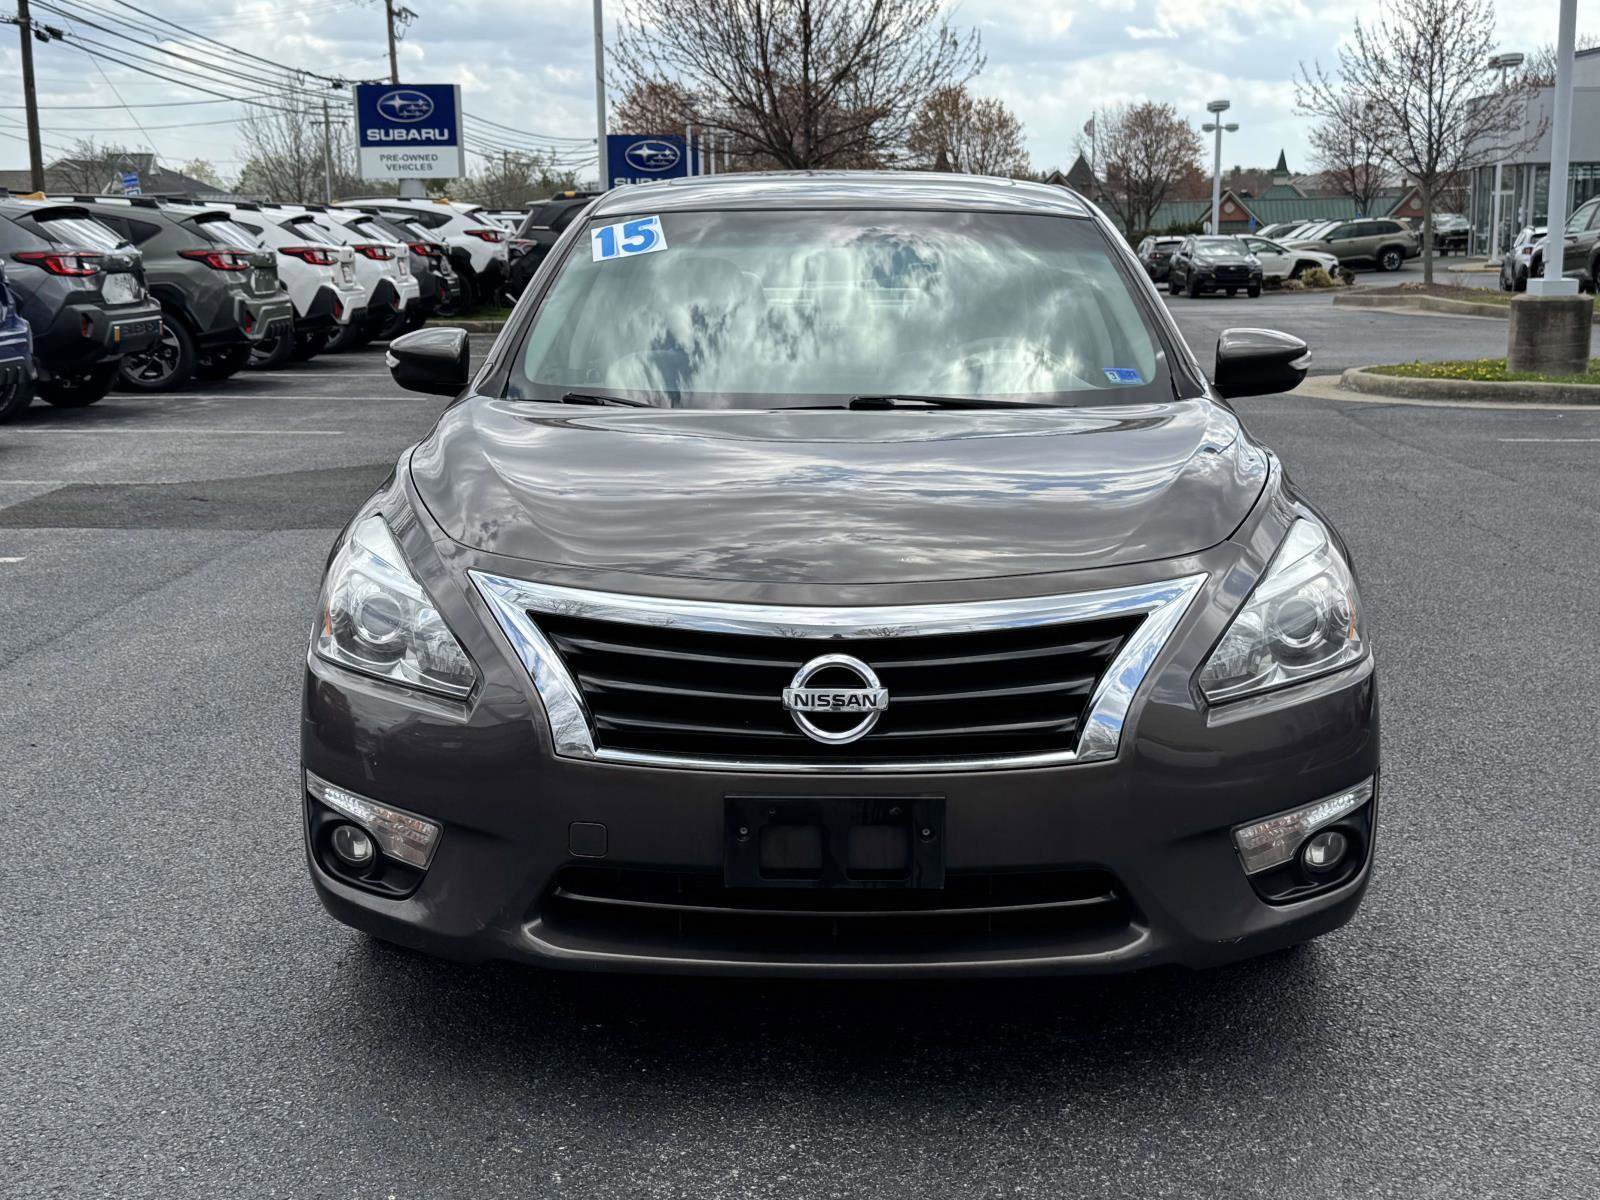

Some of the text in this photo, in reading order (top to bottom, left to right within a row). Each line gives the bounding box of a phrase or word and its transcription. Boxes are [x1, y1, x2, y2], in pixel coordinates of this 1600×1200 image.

[366, 128, 449, 141] SUBARU
[379, 154, 438, 162] PRE-OWNED
[386, 163, 433, 171] VEHICLES
[613, 177, 663, 188] SUB
[594, 217, 659, 258] 15
[794, 693, 878, 708] NISSAN
